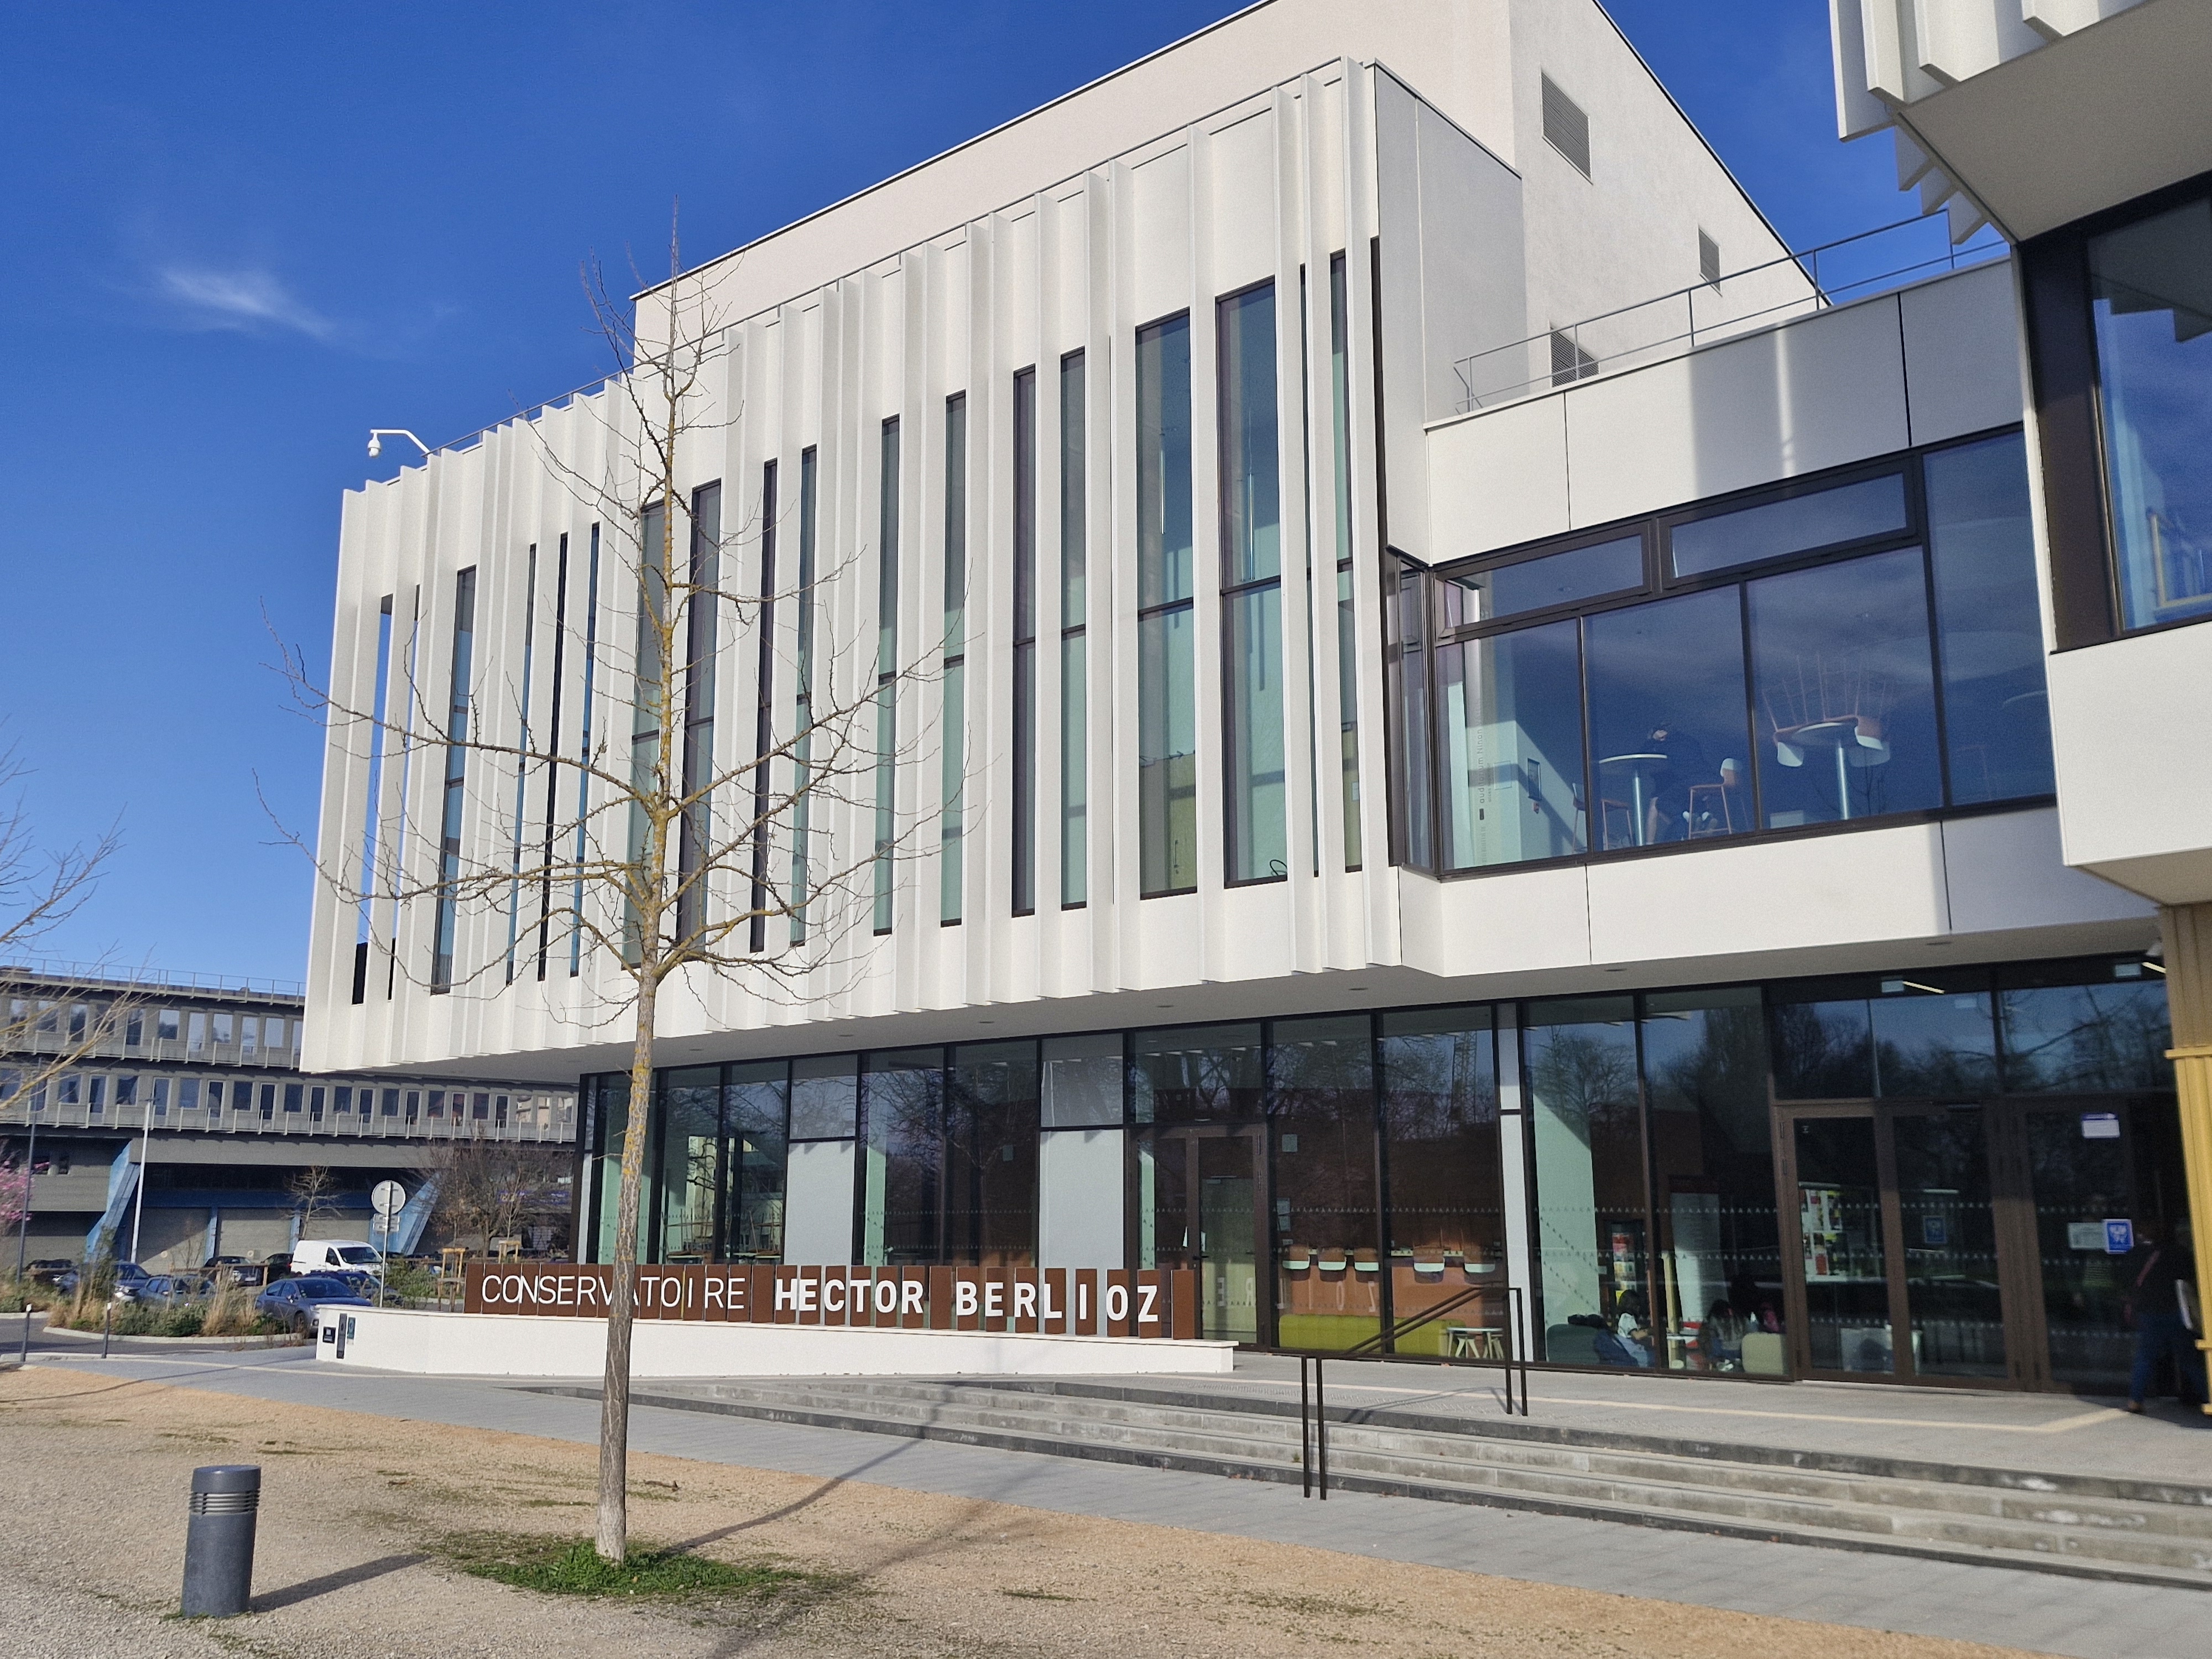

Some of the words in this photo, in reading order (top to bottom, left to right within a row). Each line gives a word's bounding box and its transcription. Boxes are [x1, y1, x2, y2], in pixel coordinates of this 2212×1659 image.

[482, 1275, 745, 1310] CONSERVTOIRE
[775, 1278, 924, 1314] HECTOR
[956, 1281, 1159, 1323] BERLIOZ
